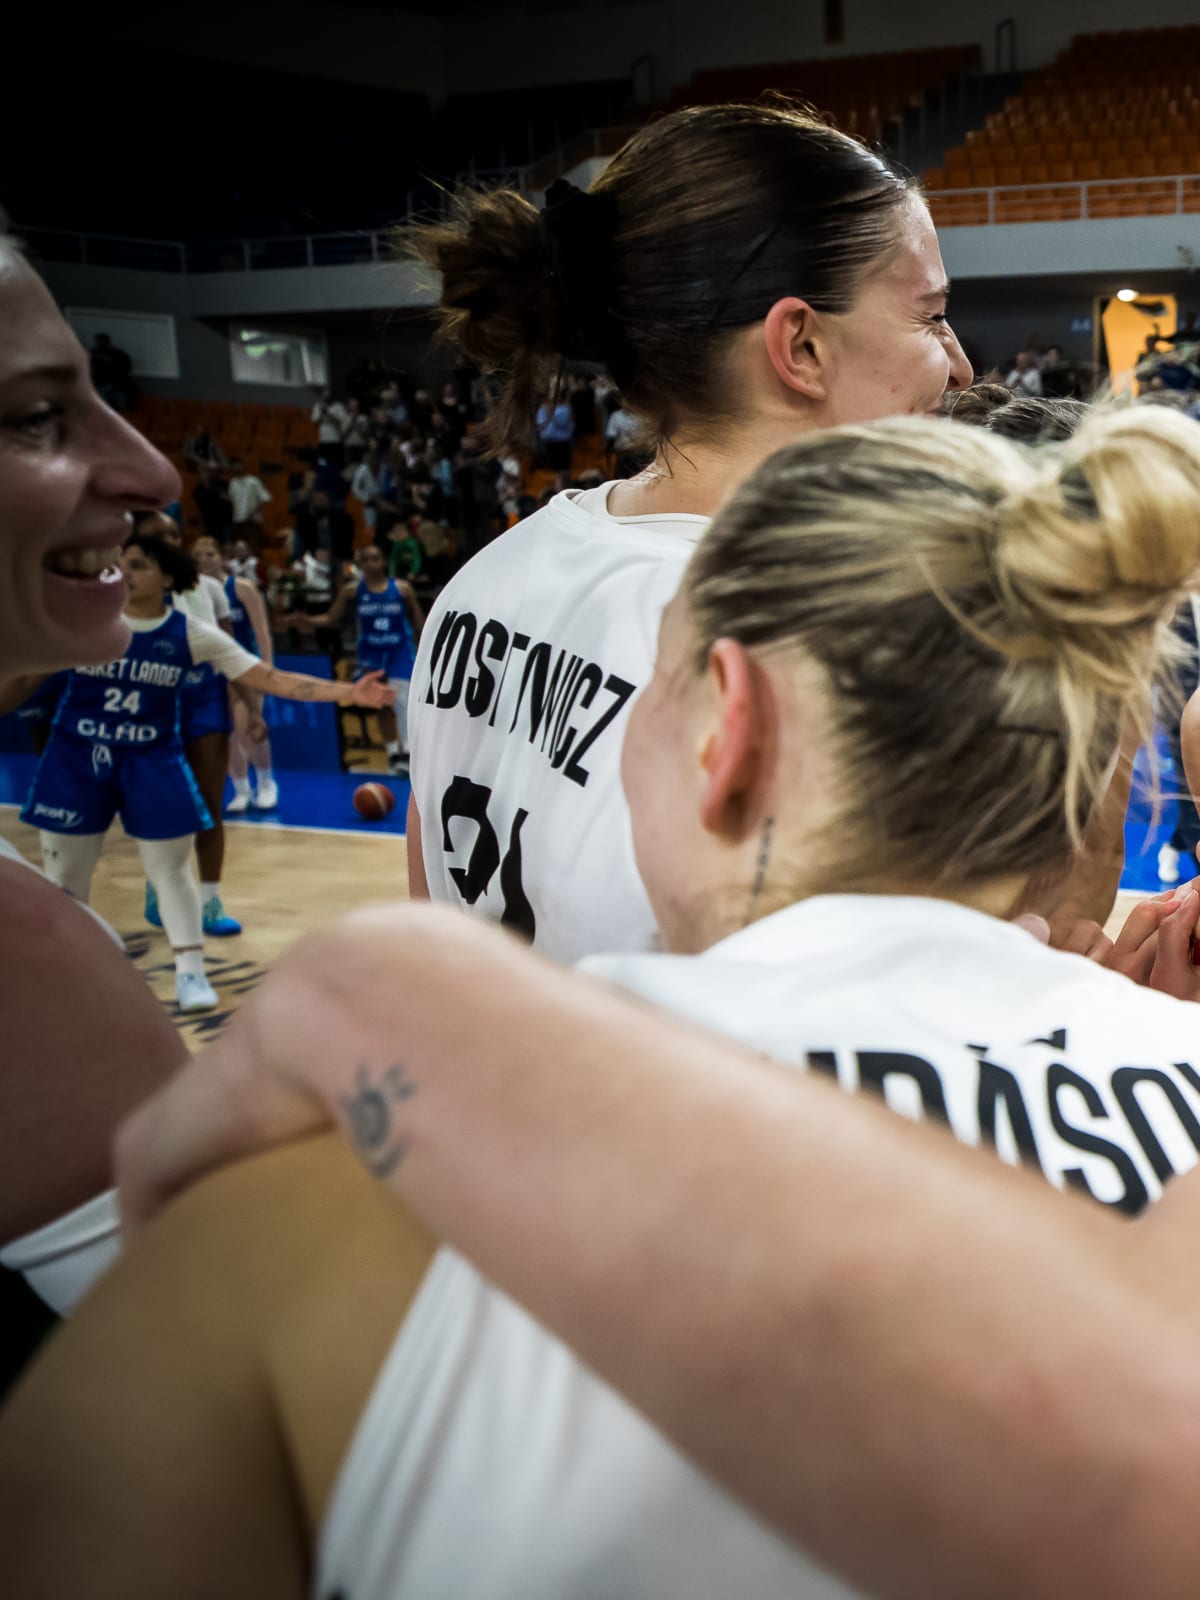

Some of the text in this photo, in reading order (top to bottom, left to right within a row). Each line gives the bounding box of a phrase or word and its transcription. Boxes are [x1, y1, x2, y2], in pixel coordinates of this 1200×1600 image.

[129, 660, 184, 688] LANDES
[103, 687, 141, 715] 24
[425, 610, 638, 788] OSTWICZ
